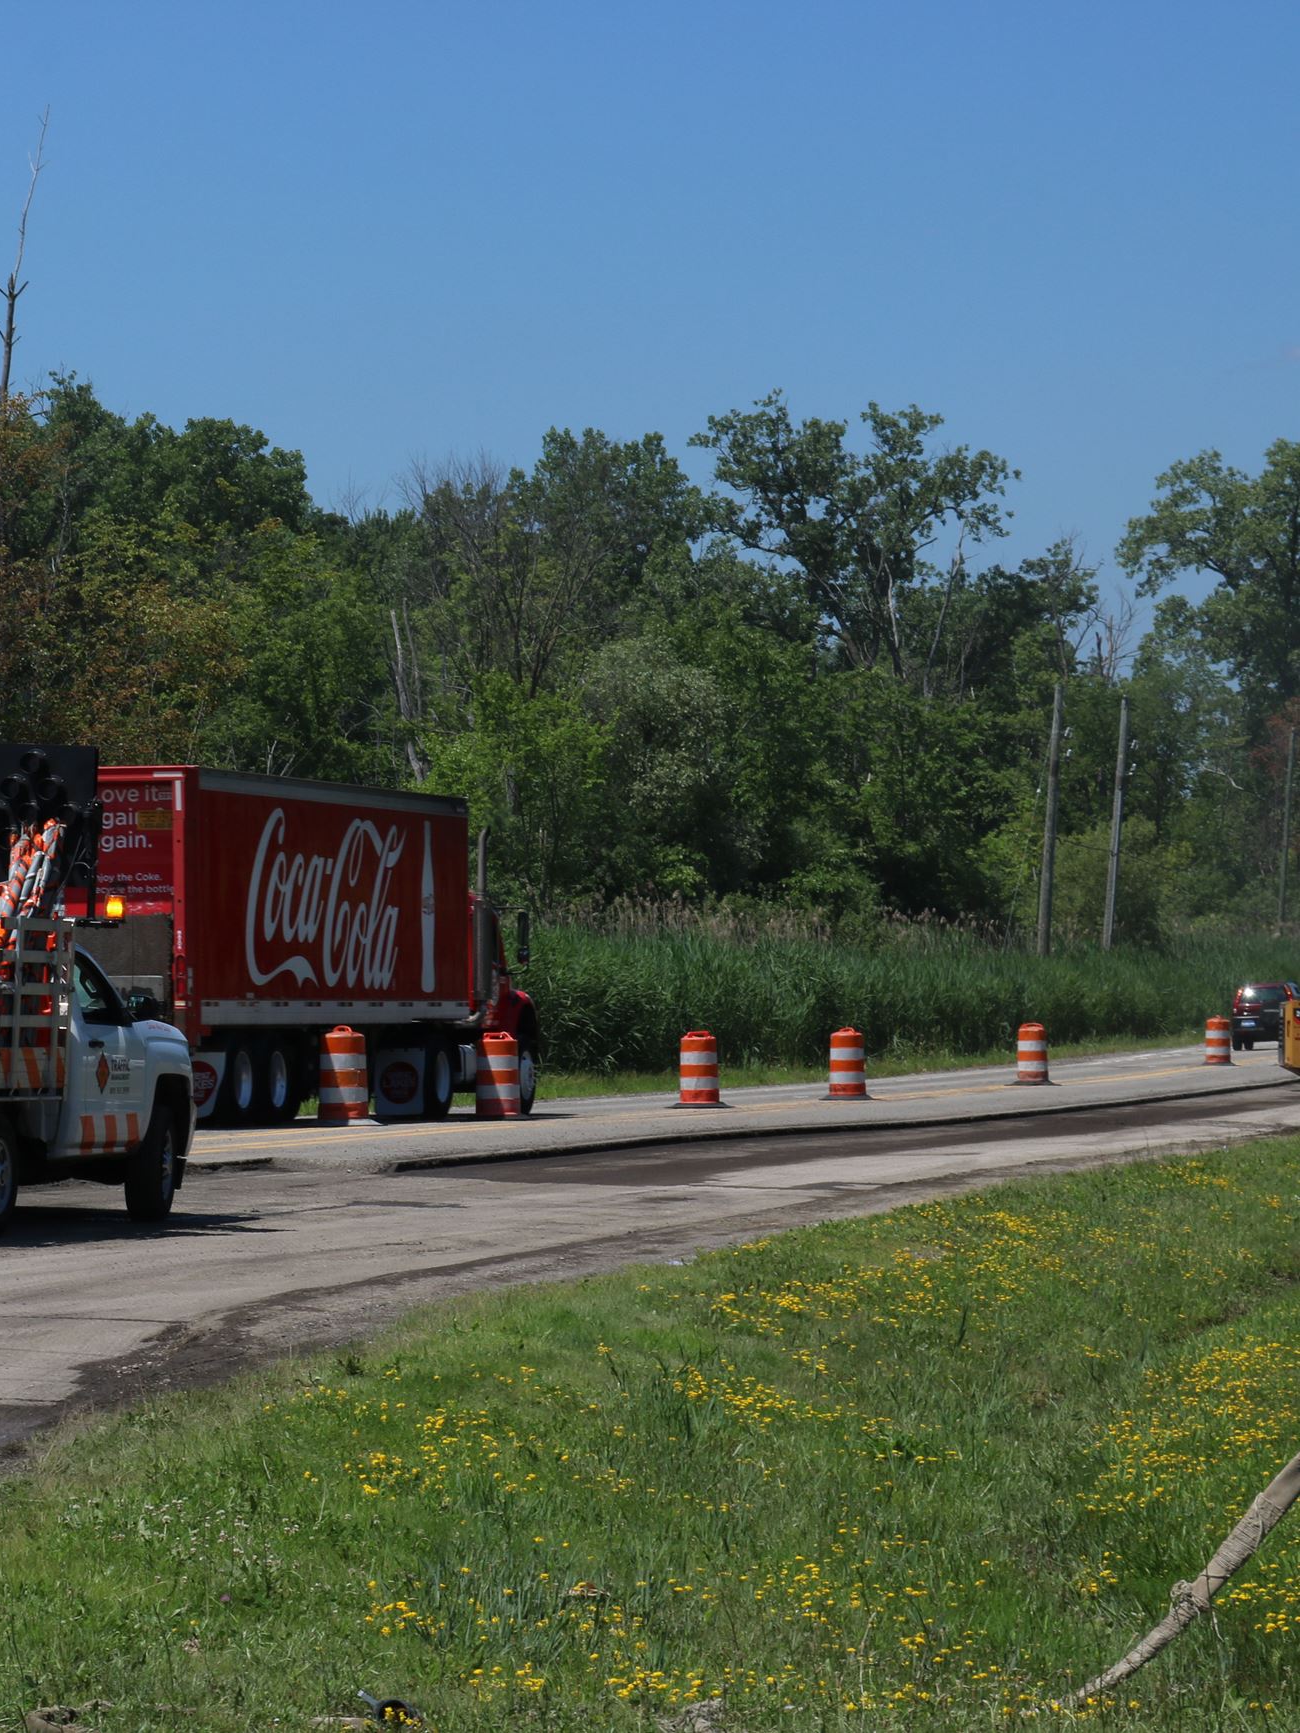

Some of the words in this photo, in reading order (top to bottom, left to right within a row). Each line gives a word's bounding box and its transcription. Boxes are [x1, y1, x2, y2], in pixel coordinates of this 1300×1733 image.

[95, 787, 140, 803] ove
[144, 785, 159, 802] it
[98, 831, 153, 852] gain.
[117, 872, 133, 881] the
[135, 872, 163, 882] Coke.
[246, 807, 408, 991] Coca-Cola
